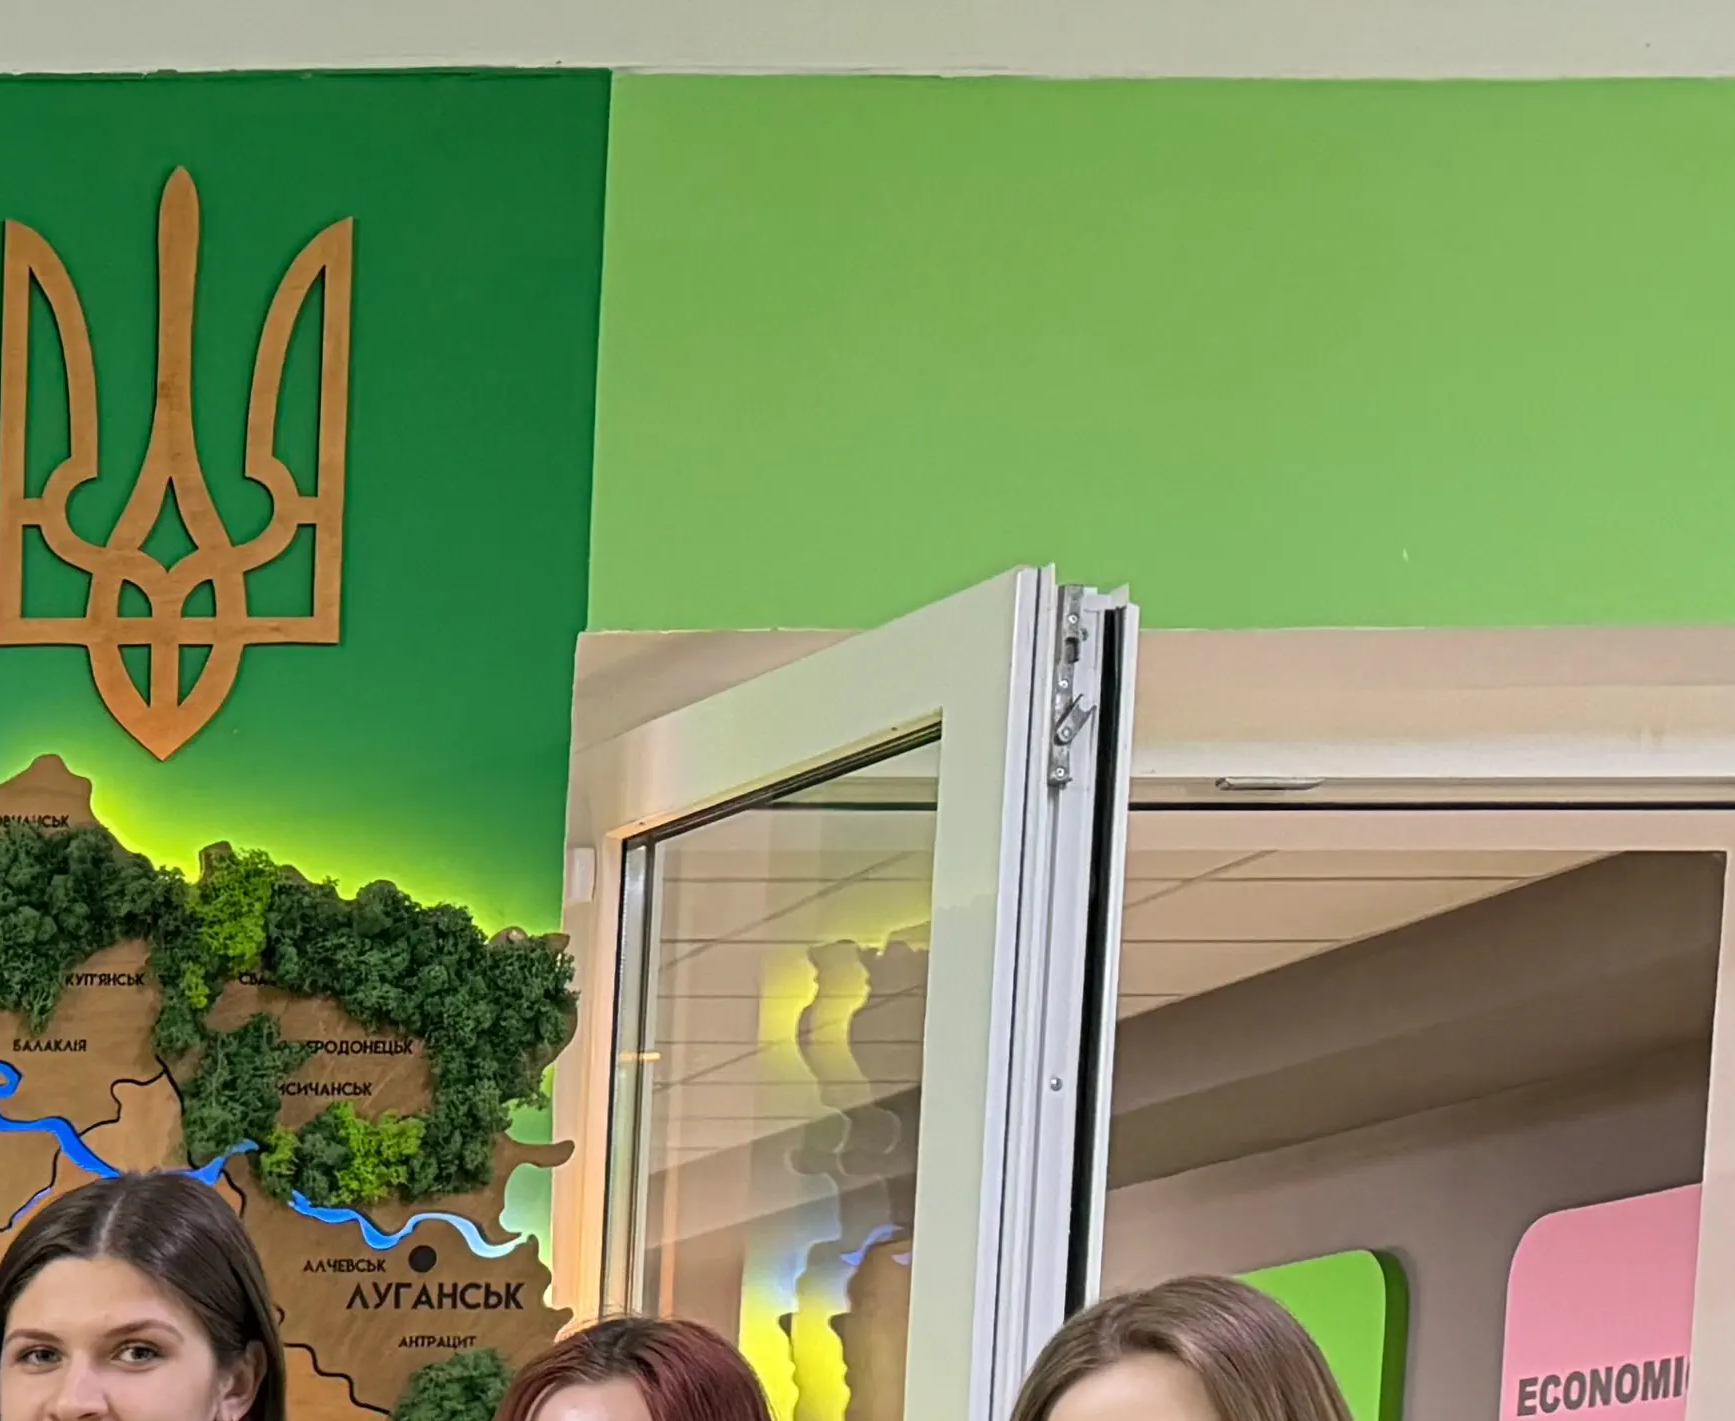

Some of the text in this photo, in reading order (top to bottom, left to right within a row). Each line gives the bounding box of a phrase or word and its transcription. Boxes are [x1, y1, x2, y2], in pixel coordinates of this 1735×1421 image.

[13, 1038, 87, 1052] БАЛАКЛІЯ
[303, 1259, 387, 1273] АЛЧЕВСЬК
[346, 1282, 525, 1311] ЛУГАНСЬК
[398, 1335, 477, 1349] АНТРАЦИТ
[1517, 1356, 1690, 1416] ECONOMI
